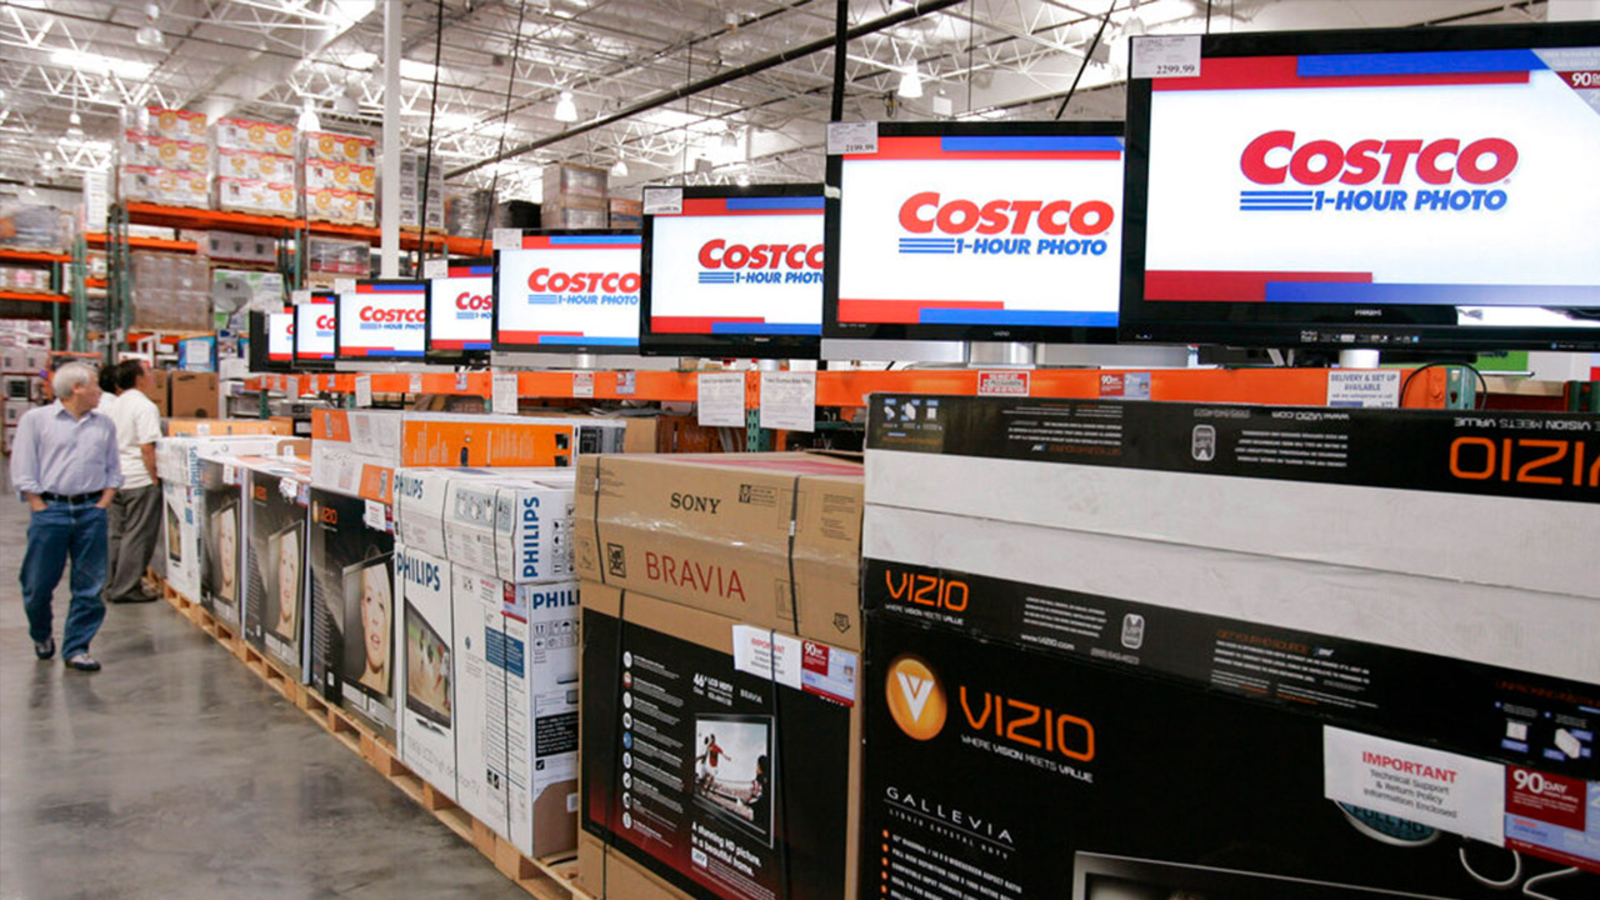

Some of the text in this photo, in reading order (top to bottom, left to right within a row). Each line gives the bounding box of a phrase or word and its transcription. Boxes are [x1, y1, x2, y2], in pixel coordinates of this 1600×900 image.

[1156, 64, 1195, 74] 2299.99
[1571, 72, 1592, 87] 90
[1240, 130, 1519, 185] COSTCO
[1314, 189, 1507, 211] 1-HOUR PHOTO
[899, 191, 1115, 236] COSTCO
[956, 238, 1107, 256] 1-HOUR PHOTO
[527, 268, 642, 294] COSTCO
[734, 271, 782, 285] 1-HOUR
[557, 294, 638, 305] 1-HOUR PHOTO
[1454, 416, 1591, 431] VISION MEETS VALUE
[1449, 436, 1600, 488] IZIO
[394, 474, 424, 499] PHILIPS
[670, 492, 722, 514] SONY
[523, 496, 540, 578] PHILIPS
[396, 552, 441, 592] PHILIPS
[645, 551, 747, 602] BRAVIA
[886, 570, 969, 612] VIZIO
[942, 613, 964, 626] VALUE
[804, 642, 816, 656] 90
[959, 686, 1095, 762] VIZIO
[961, 734, 1094, 784] WHERE VISION MEETS VALUE
[1362, 751, 1457, 783] IMPORTANT
[1371, 769, 1450, 796] Technical Support
[1376, 781, 1444, 805] & Return Policy
[1513, 769, 1568, 794] 90 DAY
[886, 786, 1013, 844] GALLEVIA
[1364, 788, 1457, 819] Information Enclosed
